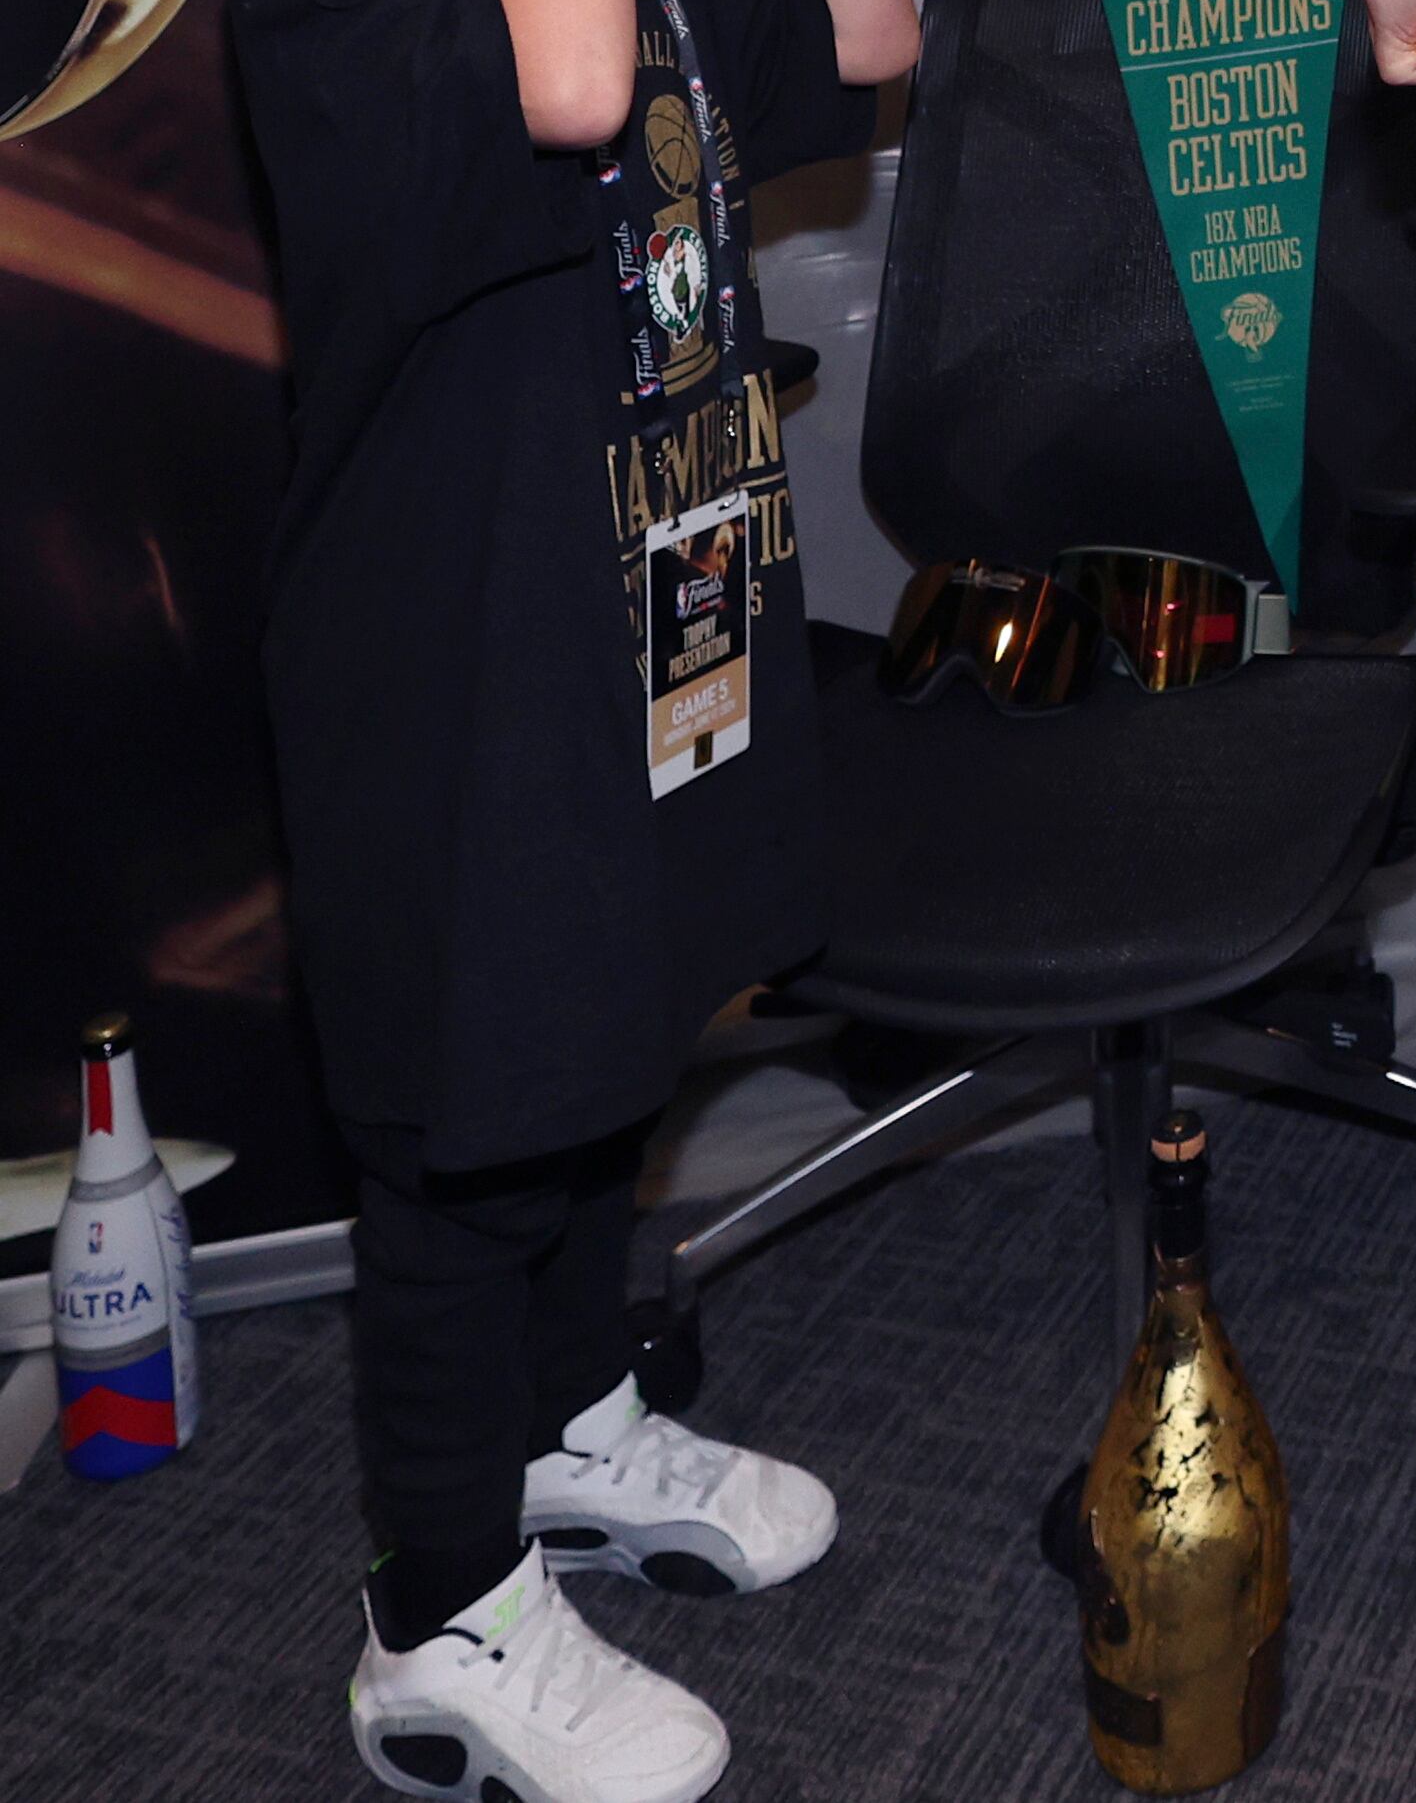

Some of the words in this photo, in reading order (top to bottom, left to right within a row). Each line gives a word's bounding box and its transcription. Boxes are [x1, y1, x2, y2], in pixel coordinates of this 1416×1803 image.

[1167, 58, 1298, 131] BOSTON
[1167, 122, 1308, 197] CELTICS
[1204, 209, 1237, 245] 18X
[1243, 203, 1282, 240] NBA
[1190, 237, 1302, 284] CHAMPIONS
[646, 261, 671, 324] BOSTON
[672, 684, 718, 726] GAME
[54, 1281, 153, 1320] ULTRA
